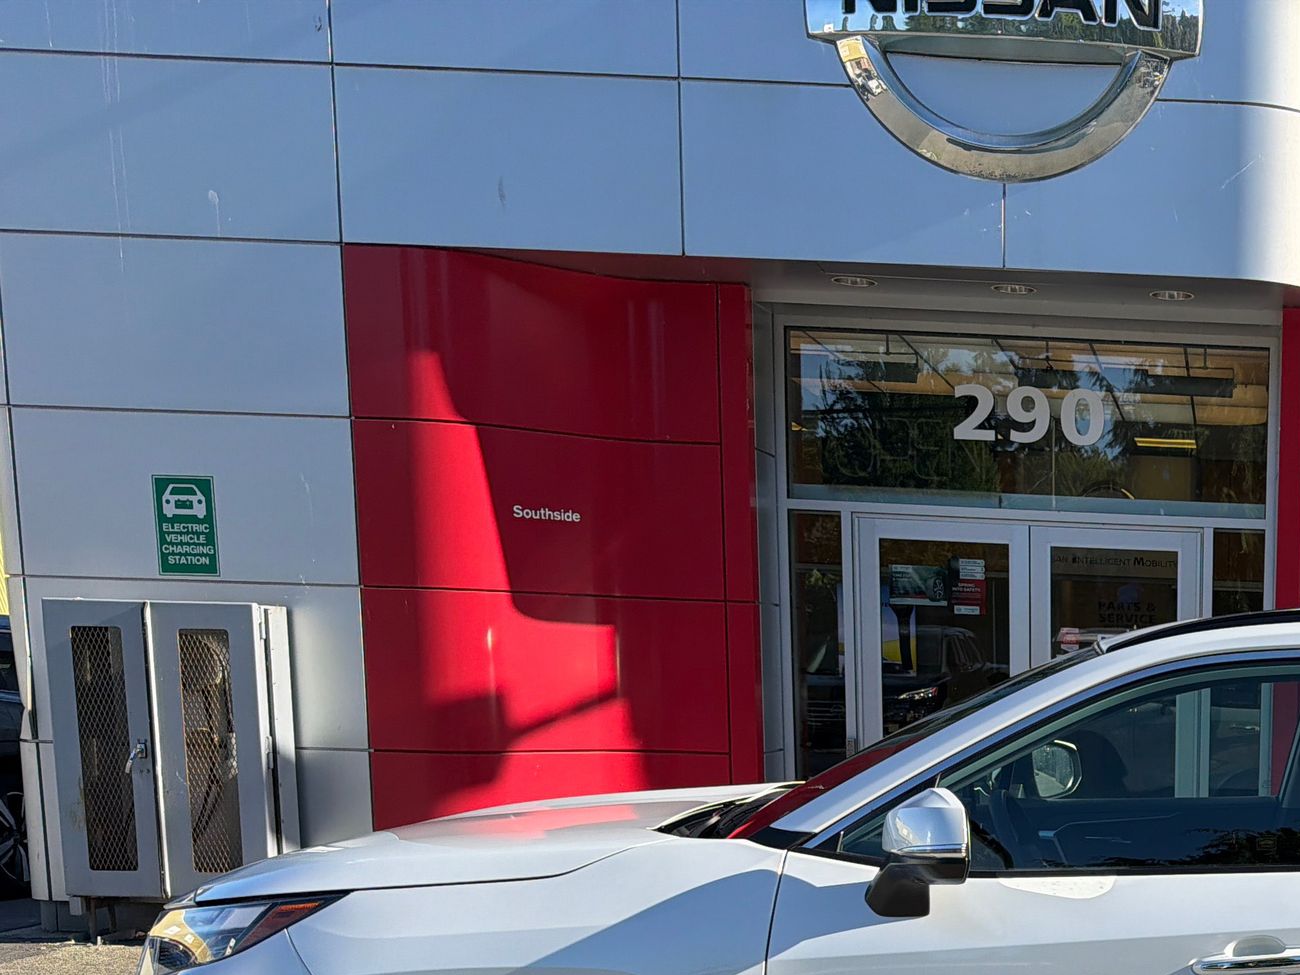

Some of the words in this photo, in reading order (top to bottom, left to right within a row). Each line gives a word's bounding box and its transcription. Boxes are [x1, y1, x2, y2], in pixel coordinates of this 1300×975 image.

[953, 383, 1105, 446] 290
[513, 504, 581, 522] Southside
[162, 523, 210, 533] ELECTRIC
[165, 534, 207, 543] VEHICLE
[162, 544, 215, 554] CHARGING
[168, 555, 210, 565] STATION
[1098, 601, 1141, 612] PARTS
[1098, 613, 1156, 624] SERVICE
